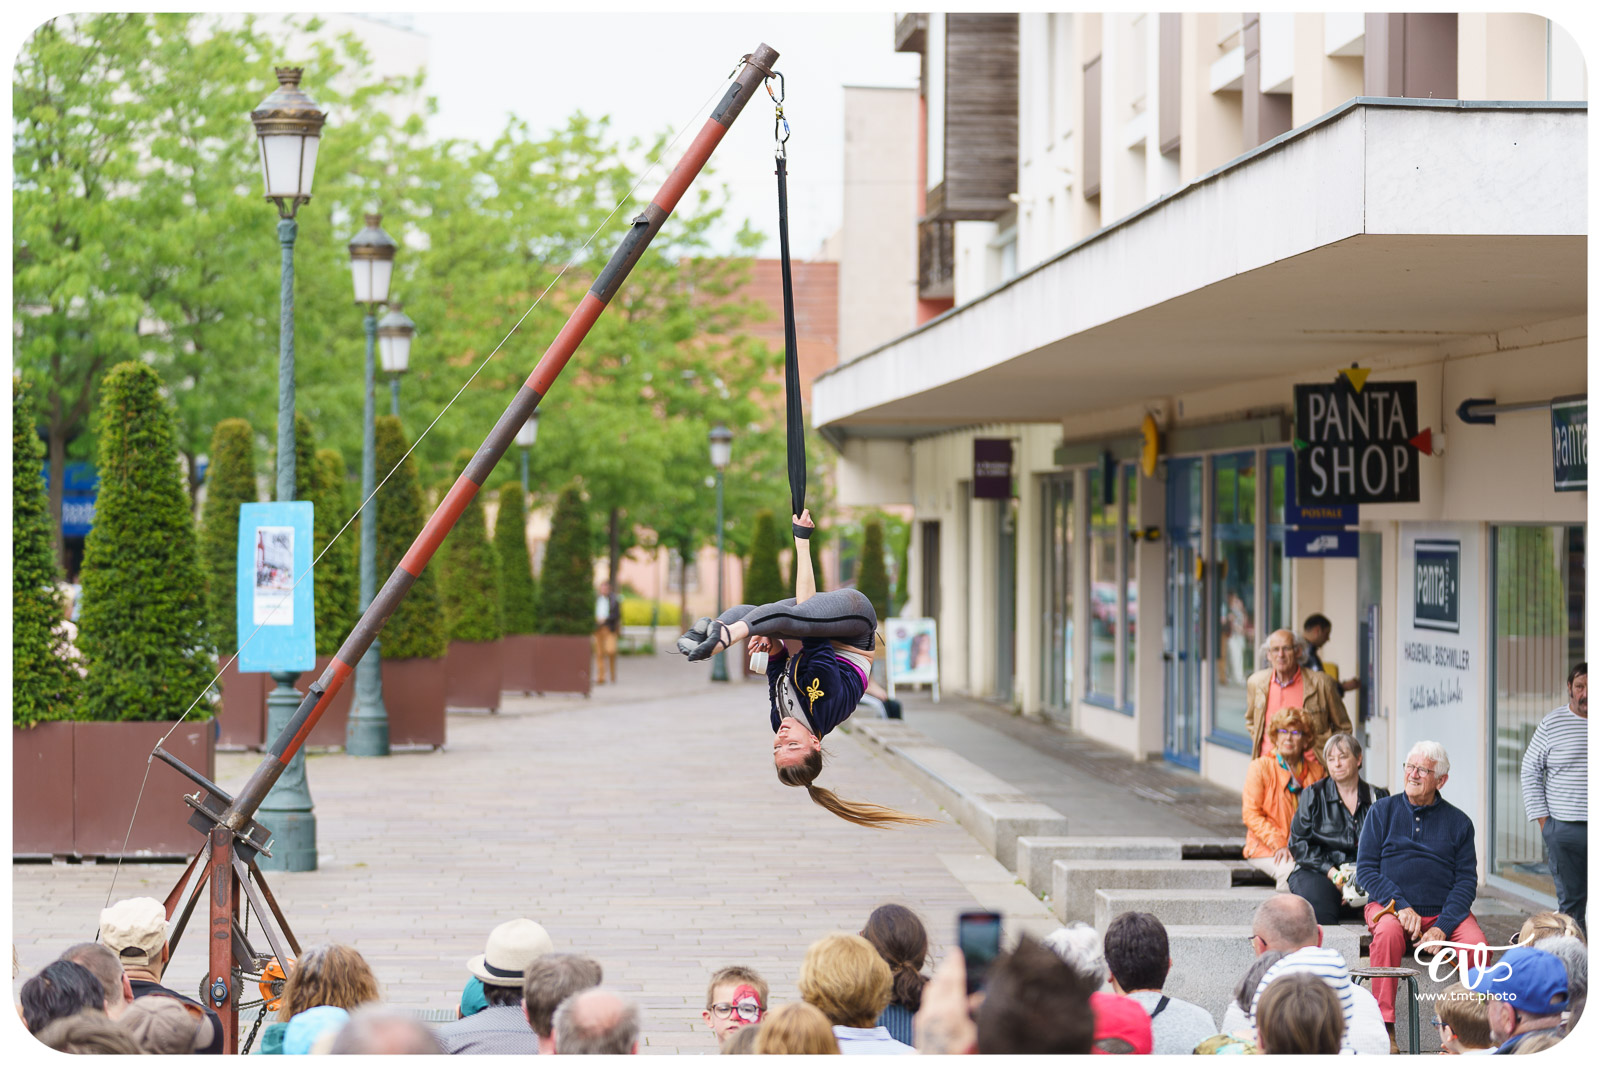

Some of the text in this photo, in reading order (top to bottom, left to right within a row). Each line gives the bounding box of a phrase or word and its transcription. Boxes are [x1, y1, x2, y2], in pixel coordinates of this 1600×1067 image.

[1309, 390, 1408, 441] PANTA
[1310, 444, 1409, 497] SHOP
[1301, 508, 1343, 519] POSTALE
